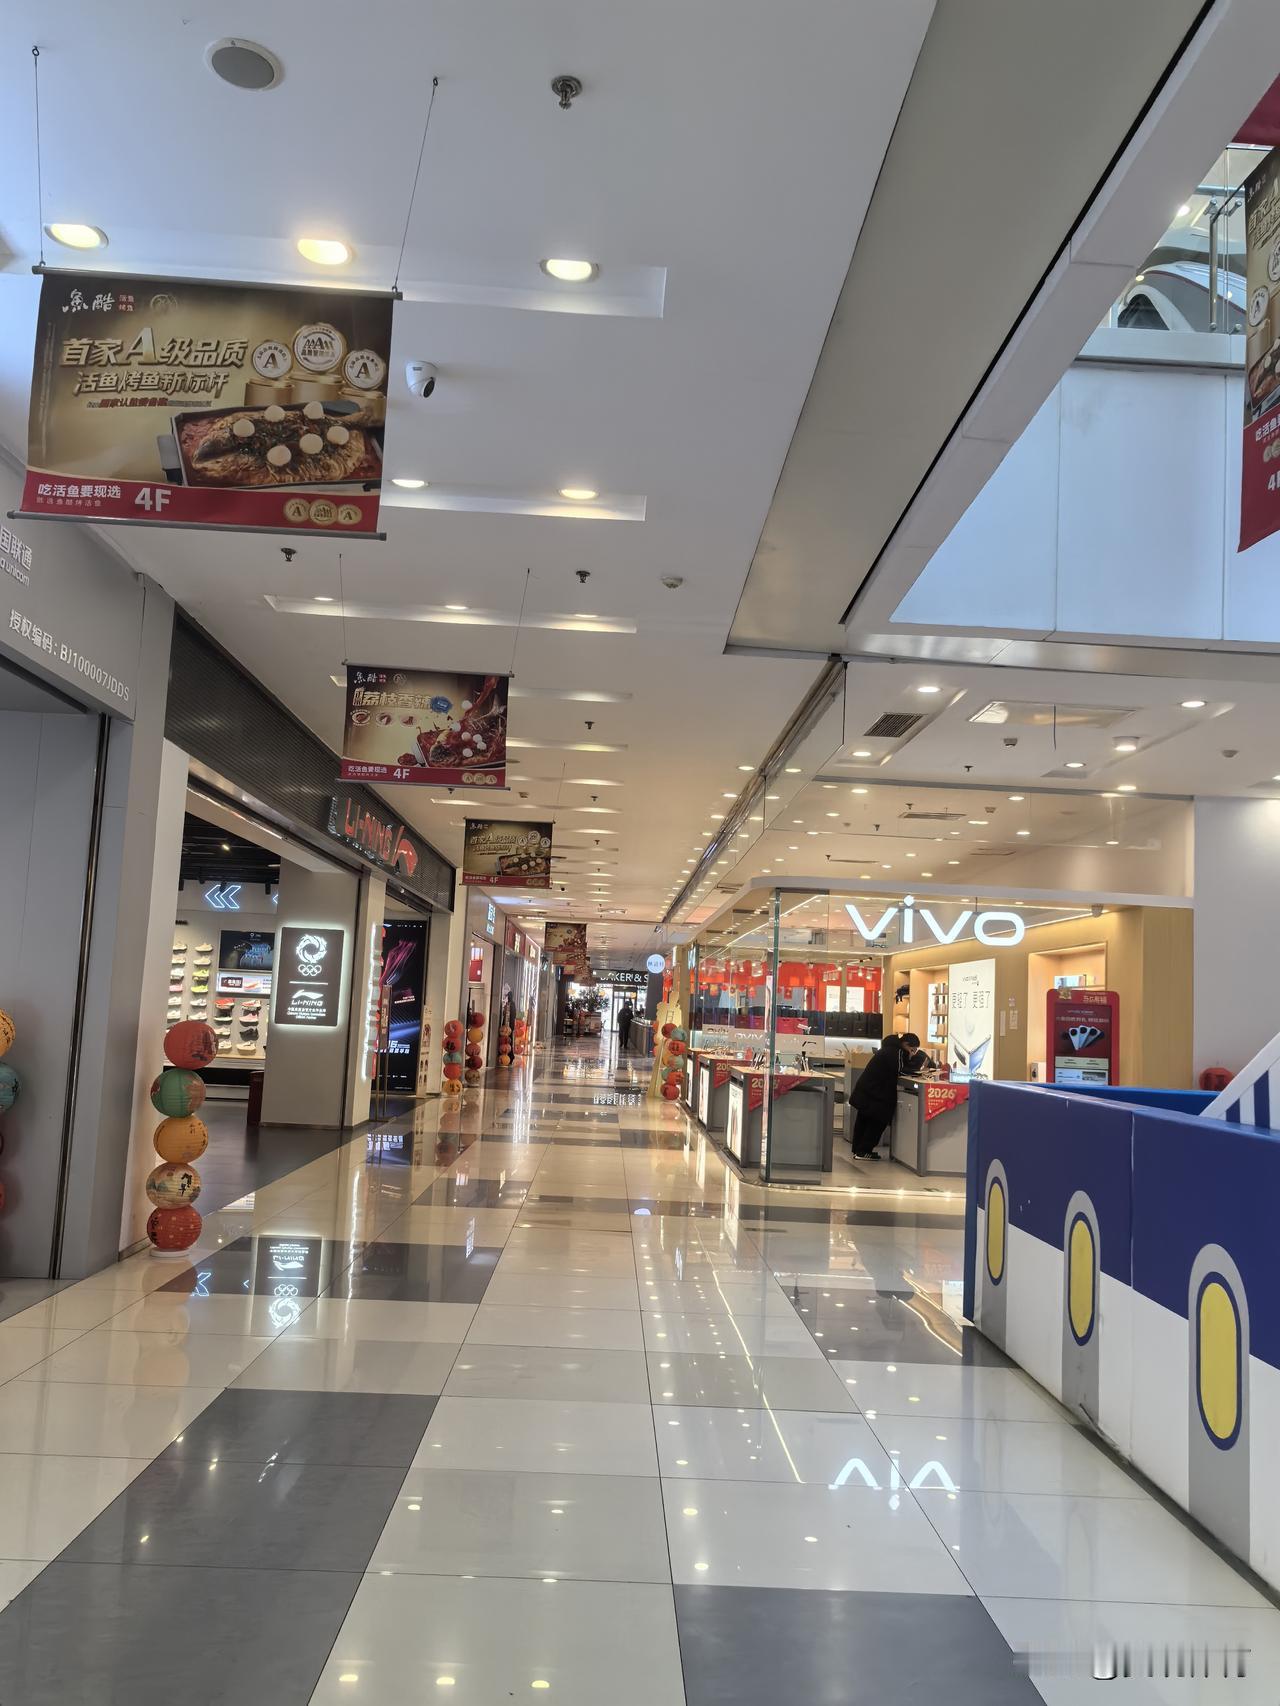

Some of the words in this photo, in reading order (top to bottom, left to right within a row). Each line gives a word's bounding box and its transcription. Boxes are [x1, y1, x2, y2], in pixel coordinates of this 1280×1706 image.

[61, 327, 248, 367] 首家A级品质
[73, 371, 229, 399] 活鱼烤鱼新标杆
[38, 483, 121, 499] 吃活鱼要现选
[134, 487, 172, 512] 4F
[393, 767, 410, 779] 4F
[845, 894, 1026, 946] vivo
[928, 1088, 957, 1099] 2026
